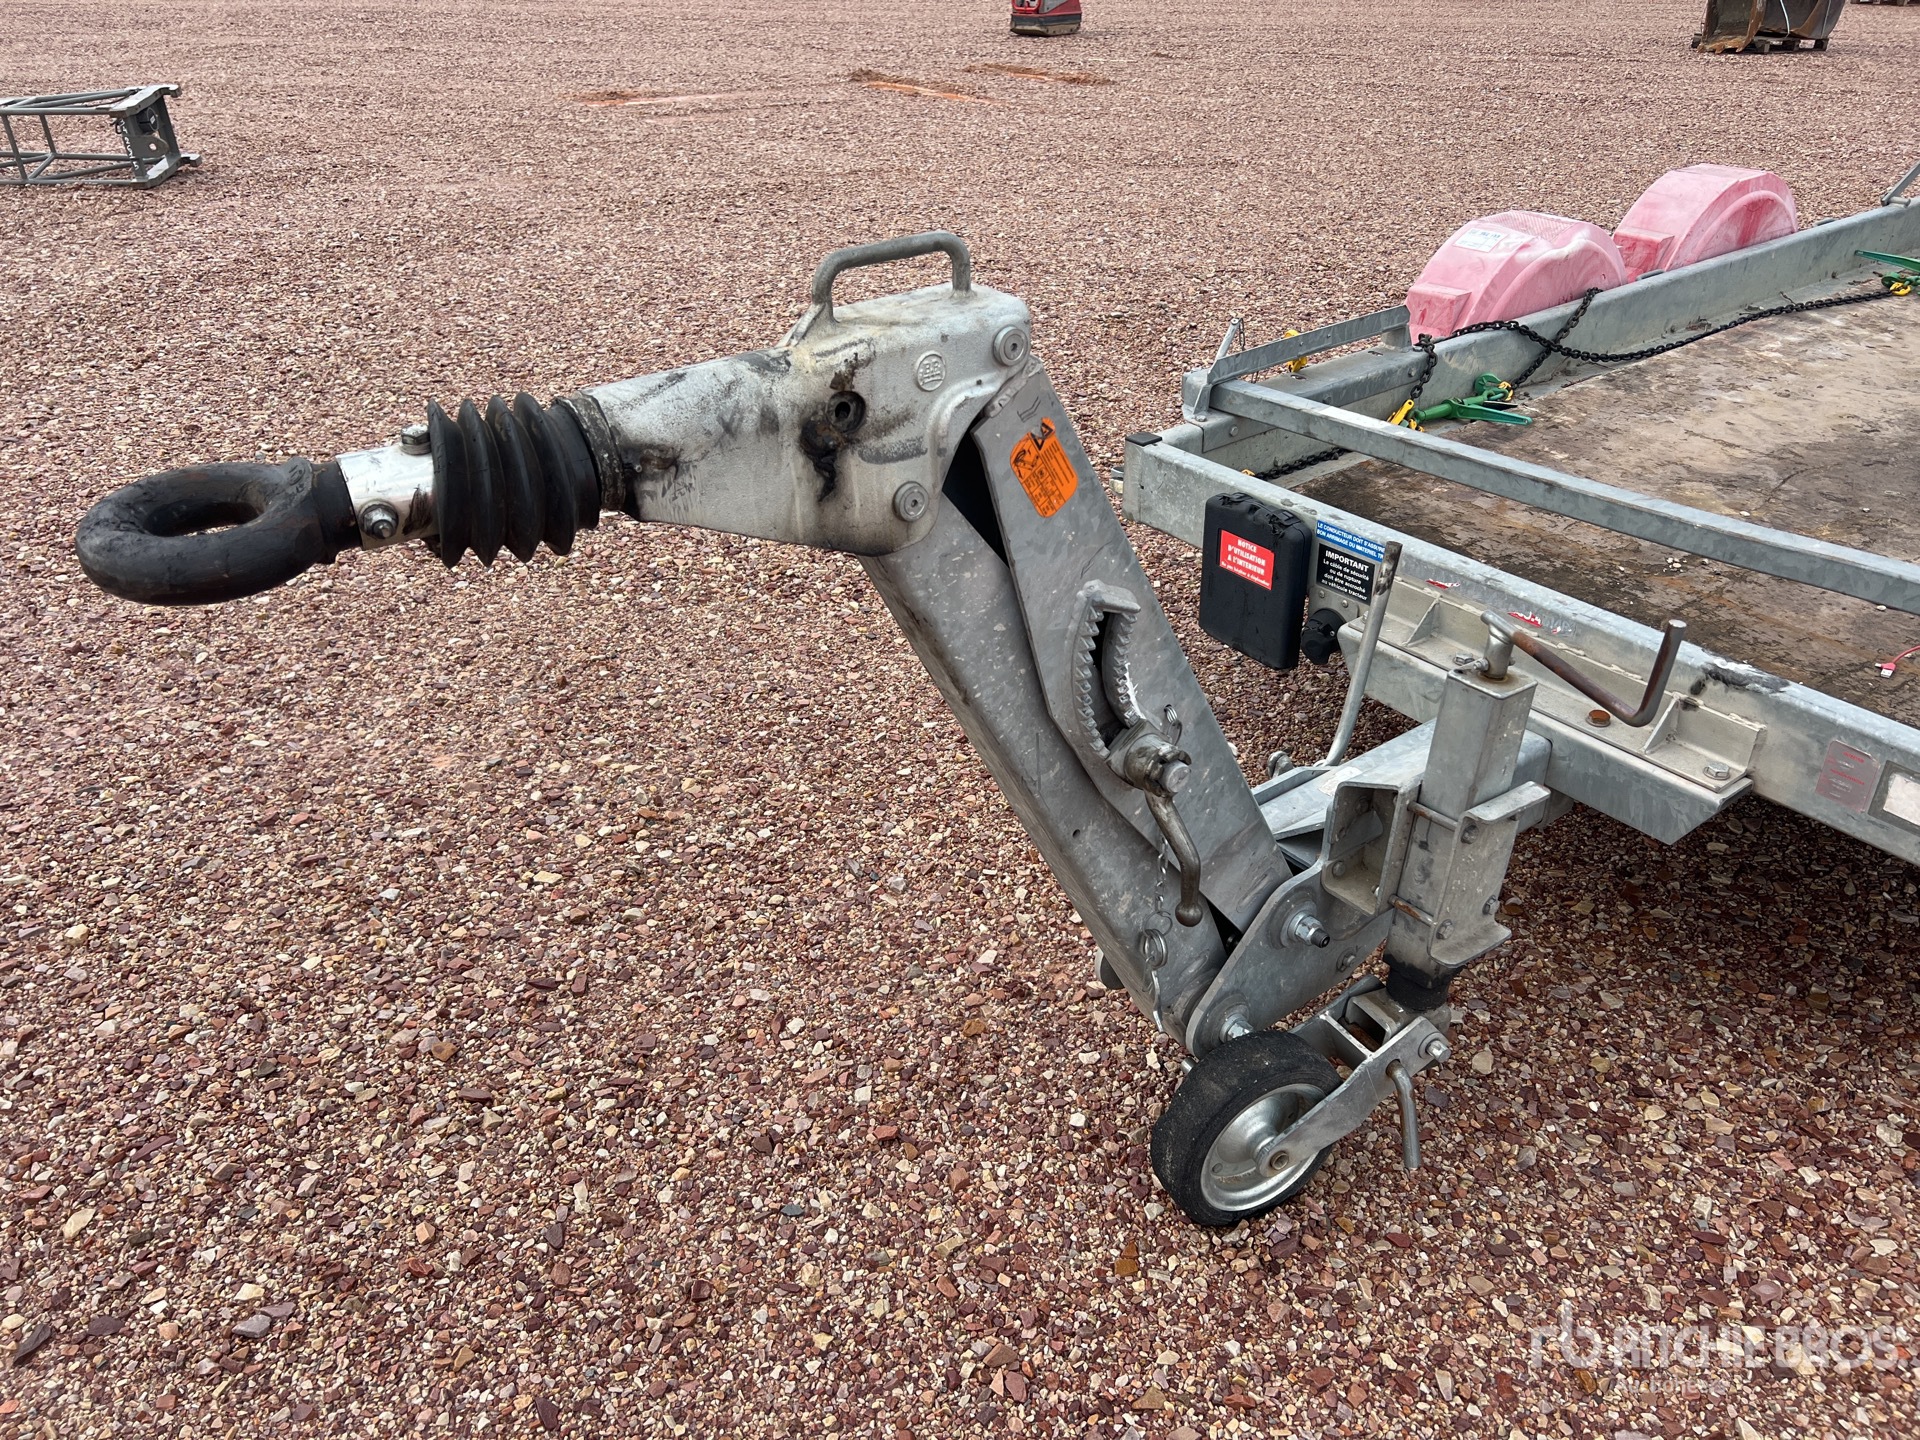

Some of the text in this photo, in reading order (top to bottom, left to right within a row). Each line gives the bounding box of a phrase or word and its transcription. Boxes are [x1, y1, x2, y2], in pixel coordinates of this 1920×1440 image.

[1324, 524, 1352, 540] CONDUCTEUR
[1353, 535, 1364, 544] DOIT
[1326, 533, 1348, 546] ARRIMAGE
[1228, 544, 1266, 566] D'UTILISATION
[1238, 539, 1257, 553] NOTICE
[1232, 556, 1265, 576] L'INTERIEUR
[1325, 550, 1369, 572] IMPORTANT
[1330, 562, 1342, 570] câble
[1350, 570, 1369, 581] sécurité
[1344, 575, 1361, 584] rupture
[1328, 582, 1348, 592] véhicule
[1348, 589, 1367, 600] tracteur
[1345, 582, 1366, 593] accroché
